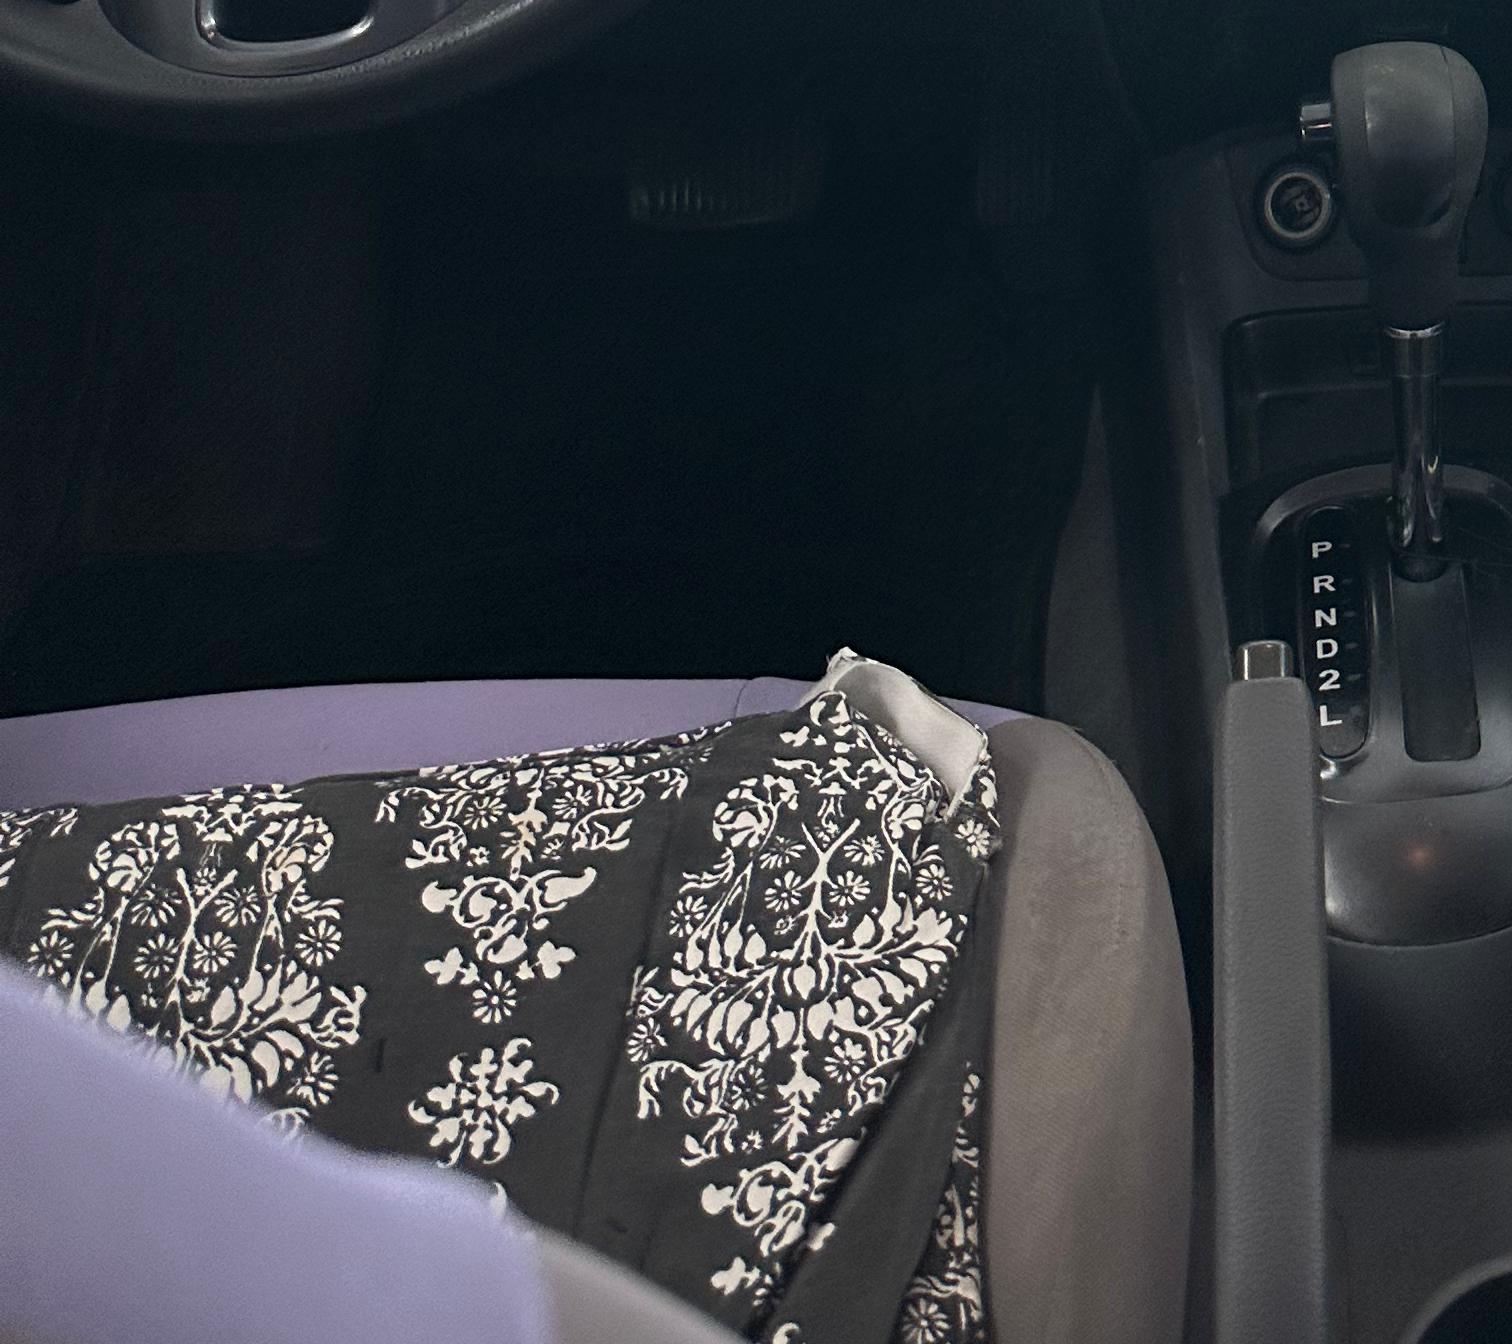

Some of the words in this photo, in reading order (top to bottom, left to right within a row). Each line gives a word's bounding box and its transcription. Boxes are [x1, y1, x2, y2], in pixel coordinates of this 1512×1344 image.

[1311, 542, 1333, 559] P
[1312, 575, 1336, 594] R
[1314, 608, 1338, 628] N
[1316, 640, 1339, 660] D
[1318, 671, 1342, 692] 2
[1319, 704, 1342, 726] L
